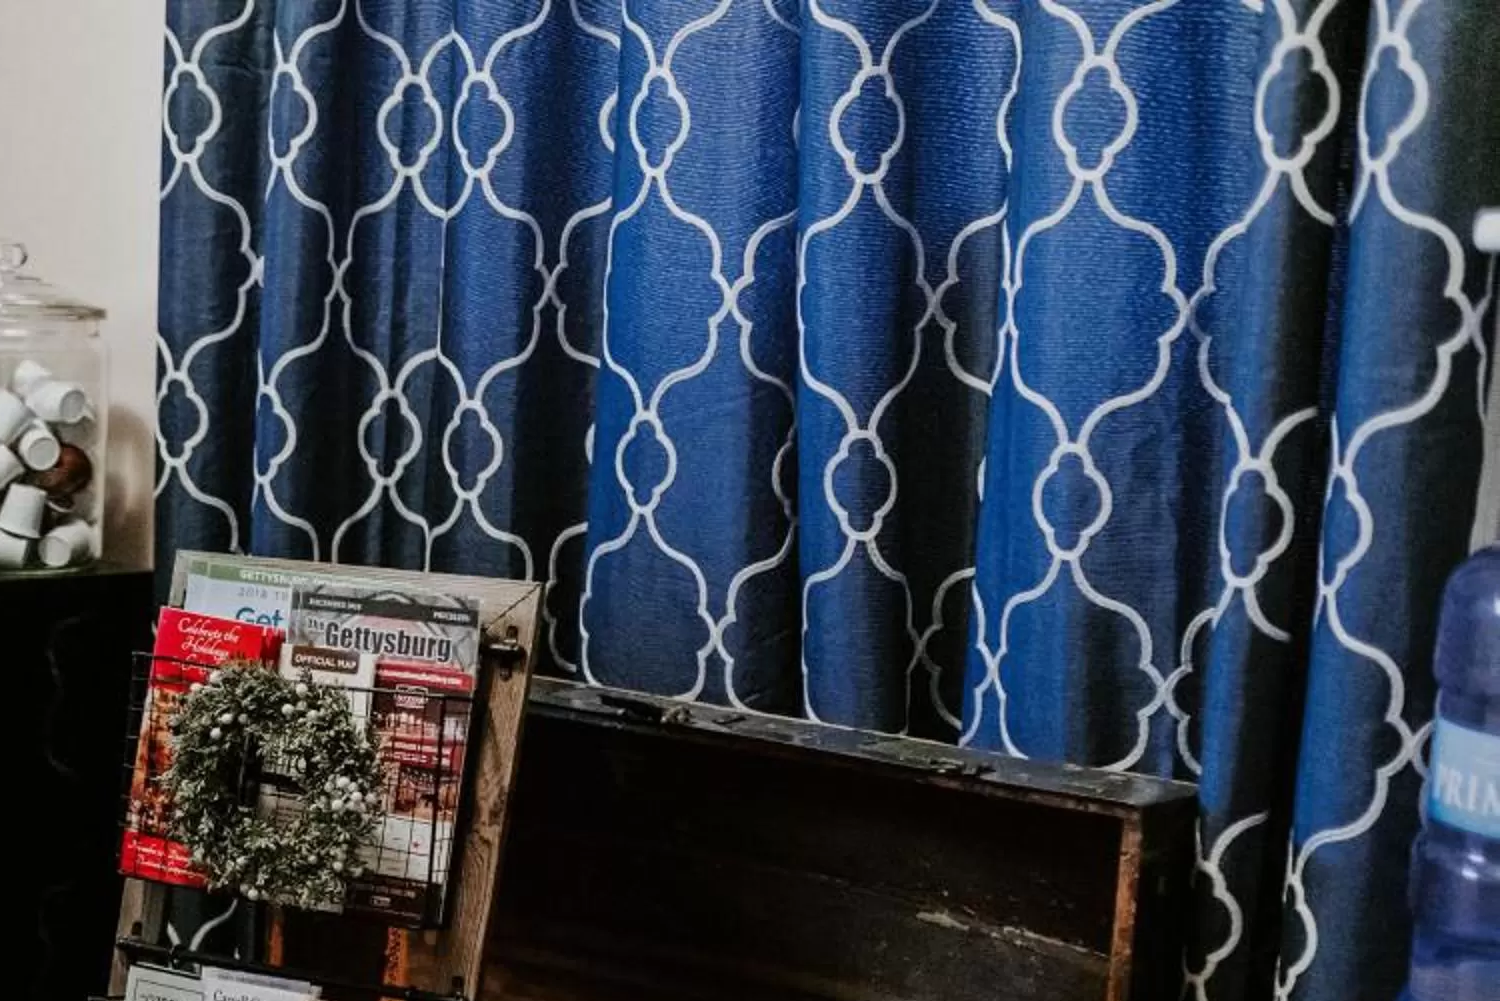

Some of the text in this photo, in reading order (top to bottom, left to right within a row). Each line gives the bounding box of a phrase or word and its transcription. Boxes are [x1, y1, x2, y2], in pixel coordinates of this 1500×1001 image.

[325, 621, 451, 663] Gettysburg
[295, 653, 357, 669] OFFICIAL MAP
